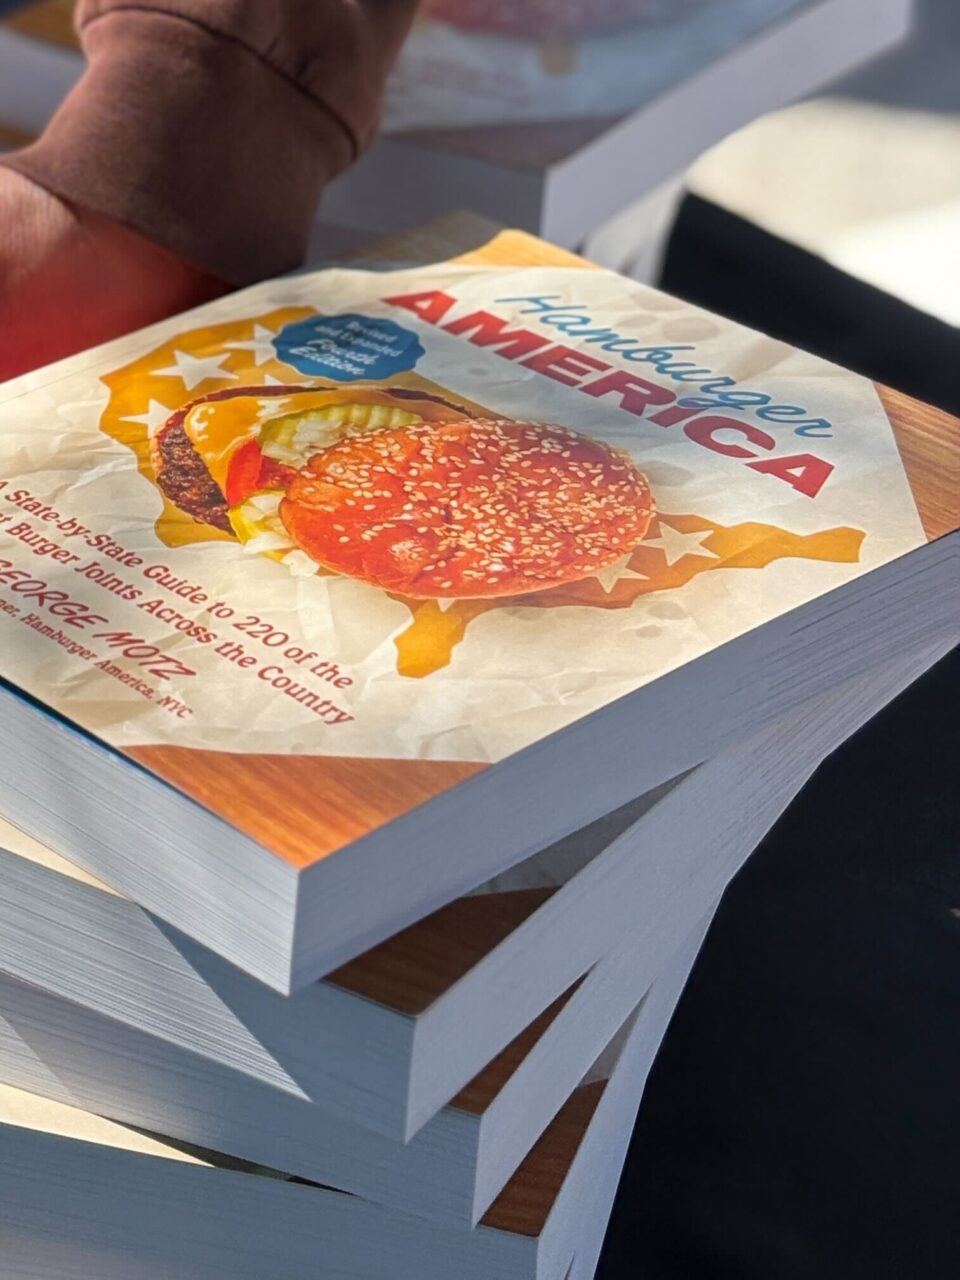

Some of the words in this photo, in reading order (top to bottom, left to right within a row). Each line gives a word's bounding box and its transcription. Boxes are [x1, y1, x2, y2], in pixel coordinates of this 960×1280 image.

[380, 289, 836, 499] AMERICA
[494, 295, 834, 439] Hamburger
[4, 489, 144, 569] State-by-State
[142, 564, 209, 605] Guide
[206, 599, 236, 620] to
[231, 615, 290, 648] 220
[283, 644, 319, 665] of
[309, 661, 354, 690] the
[5, 522, 81, 566] Burger
[74, 560, 144, 601] Joints
[136, 598, 219, 645] Across
[214, 640, 258, 669] the
[256, 665, 355, 726] Country
[19, 612, 99, 662] Hamburger
[155, 694, 194, 720] NYC
[91, 631, 198, 682] MOTZ
